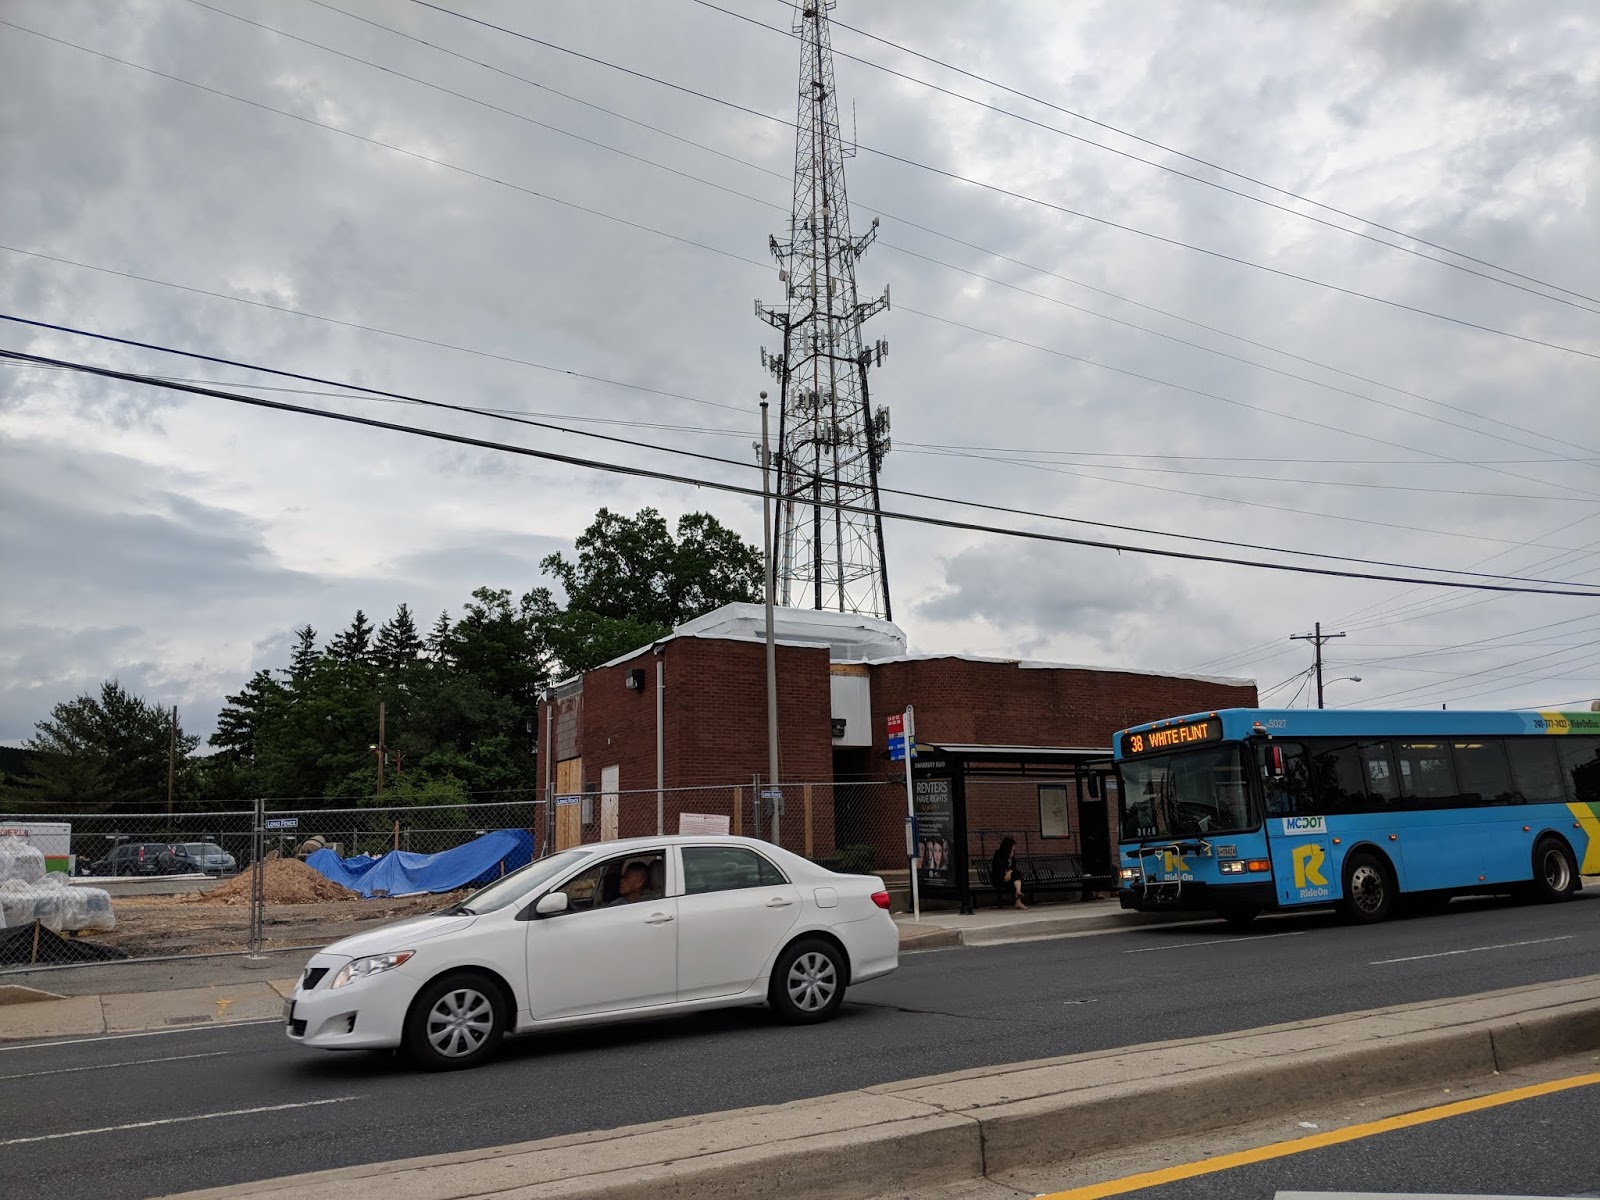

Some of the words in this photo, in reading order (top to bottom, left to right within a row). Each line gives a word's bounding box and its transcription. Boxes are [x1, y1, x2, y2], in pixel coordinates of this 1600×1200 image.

[1269, 719, 1287, 728] 5027
[1130, 734, 1144, 753] 38
[1148, 729, 1180, 748] WHITE
[1180, 723, 1208, 743] FLINT
[916, 781, 948, 794] RENTERS
[916, 795, 929, 804] HAVE
[930, 794, 948, 803] RIGHTS
[1287, 817, 1323, 830] MCDOT
[1292, 844, 1328, 888] R
